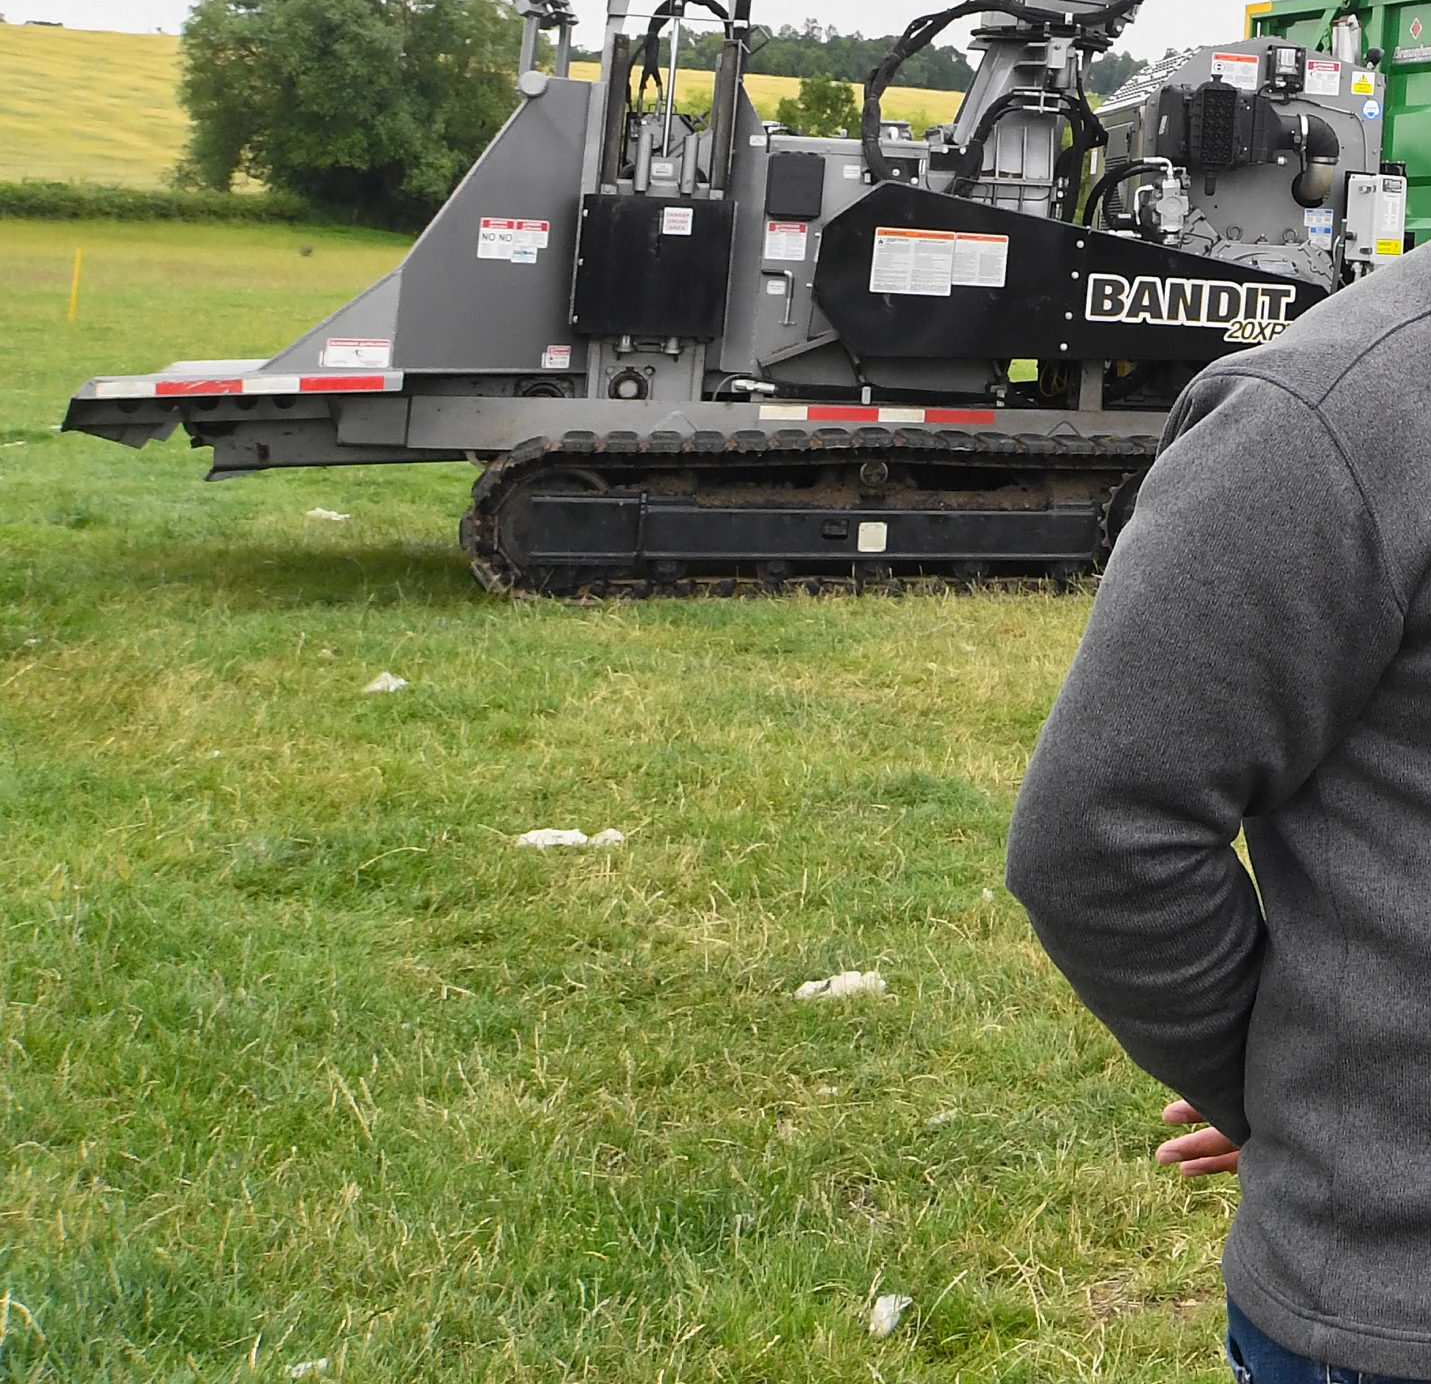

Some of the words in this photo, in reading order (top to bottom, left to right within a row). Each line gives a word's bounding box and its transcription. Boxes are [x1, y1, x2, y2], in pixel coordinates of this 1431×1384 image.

[482, 233, 496, 242] NO
[499, 234, 513, 243] NO
[1088, 276, 1293, 325] BANDIT
[1226, 320, 1292, 342] 20XP
